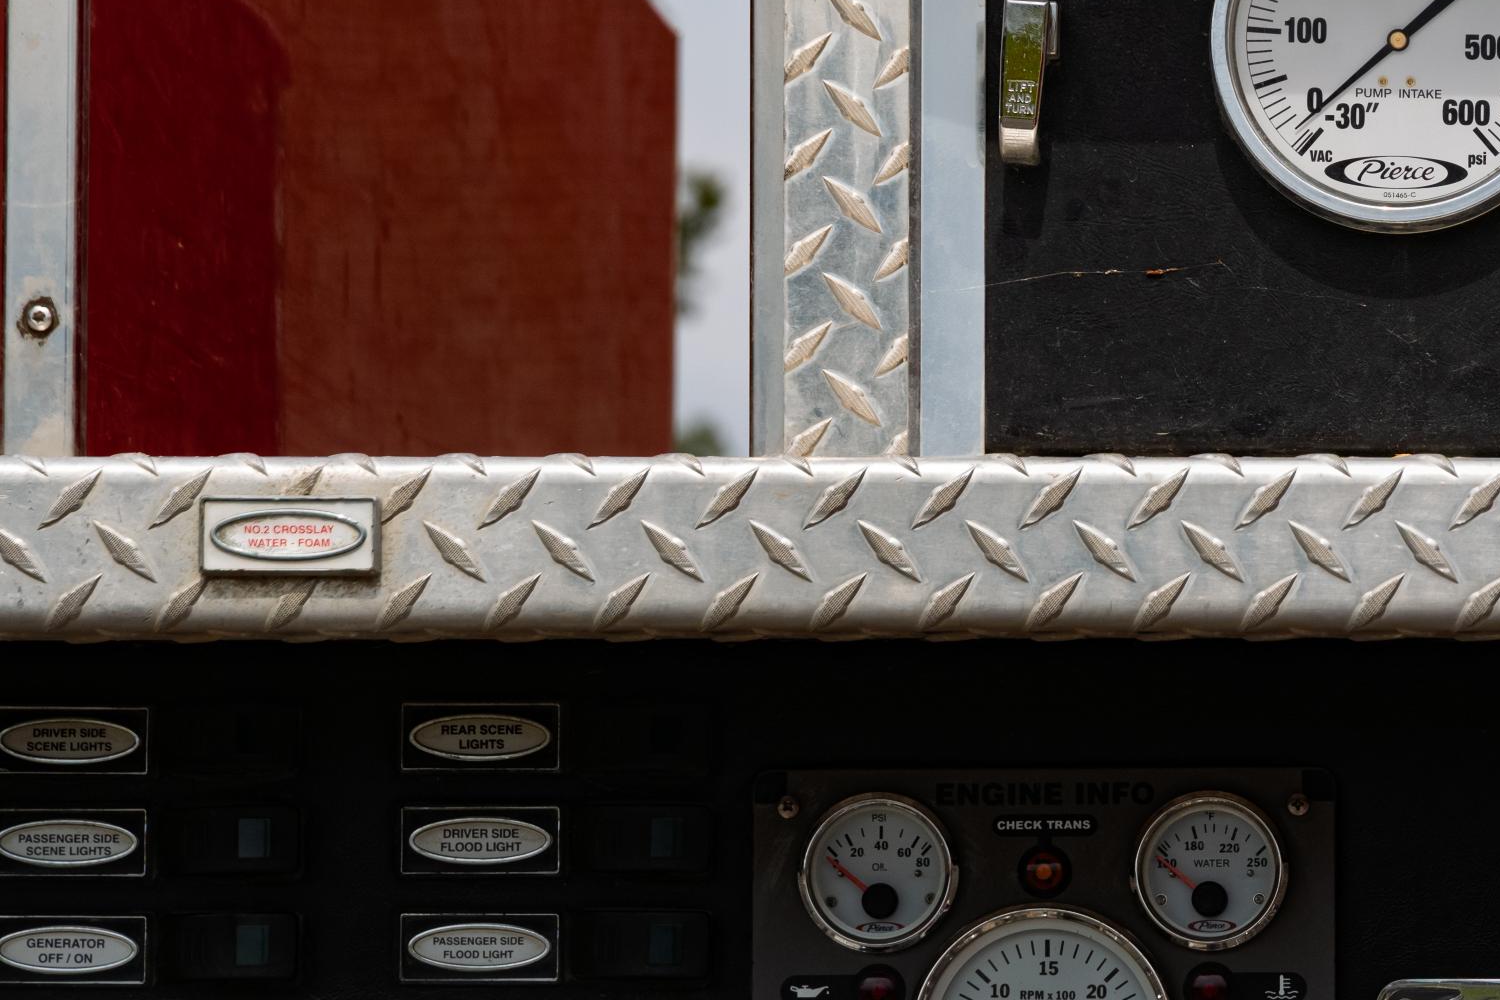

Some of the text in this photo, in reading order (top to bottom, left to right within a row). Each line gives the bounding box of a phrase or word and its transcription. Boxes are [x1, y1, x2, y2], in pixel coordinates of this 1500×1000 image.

[1285, 17, 1327, 44] 100
[1008, 82, 1035, 94] LIFT
[1009, 94, 1032, 103] AND
[1355, 88, 1442, 99] PUMP INTAKE
[1307, 88, 1323, 113] 0
[1006, 104, 1035, 115] TURN
[1442, 100, 1490, 126] 600
[1310, 150, 1333, 162] VAC
[1468, 152, 1487, 168] psi
[1357, 160, 1435, 181] Pierce
[274, 525, 334, 534] CROSSLAY
[248, 538, 287, 548] WATER
[298, 538, 331, 548] FOAM
[32, 728, 107, 738] DRIVER SIDE
[441, 724, 523, 735] REAR SCENE
[26, 741, 112, 752] SCENE LIGHTS
[458, 739, 505, 750] LIGHTS
[936, 782, 1155, 805] ENGINE INFO
[872, 814, 887, 823] PSI
[996, 820, 1092, 830] CHECK TRANS
[443, 828, 520, 839] DRIVER SIDE
[18, 834, 120, 844] PASSENGER SIDE
[440, 842, 522, 852] FLOOD LIGHT
[874, 841, 889, 850] 40
[1185, 841, 1205, 851] 180
[1219, 844, 1240, 854] 220
[26, 846, 112, 856] SCENE LIGHTS
[850, 848, 864, 858] 20
[897, 848, 911, 858] 60
[916, 858, 930, 867] 80
[1194, 859, 1230, 868] WATER
[1247, 858, 1268, 868] 250
[26, 938, 105, 949] GENERATOR
[433, 936, 524, 946] PASSENGER SIDE
[38, 953, 64, 964] OFF
[74, 953, 93, 964] ON
[443, 950, 514, 960] FLOOD LIGHT
[1039, 961, 1059, 976] 15
[991, 983, 1010, 998] 10
[1020, 990, 1045, 999] RPM
[1057, 990, 1076, 999] 100
[1087, 984, 1107, 999] 20
